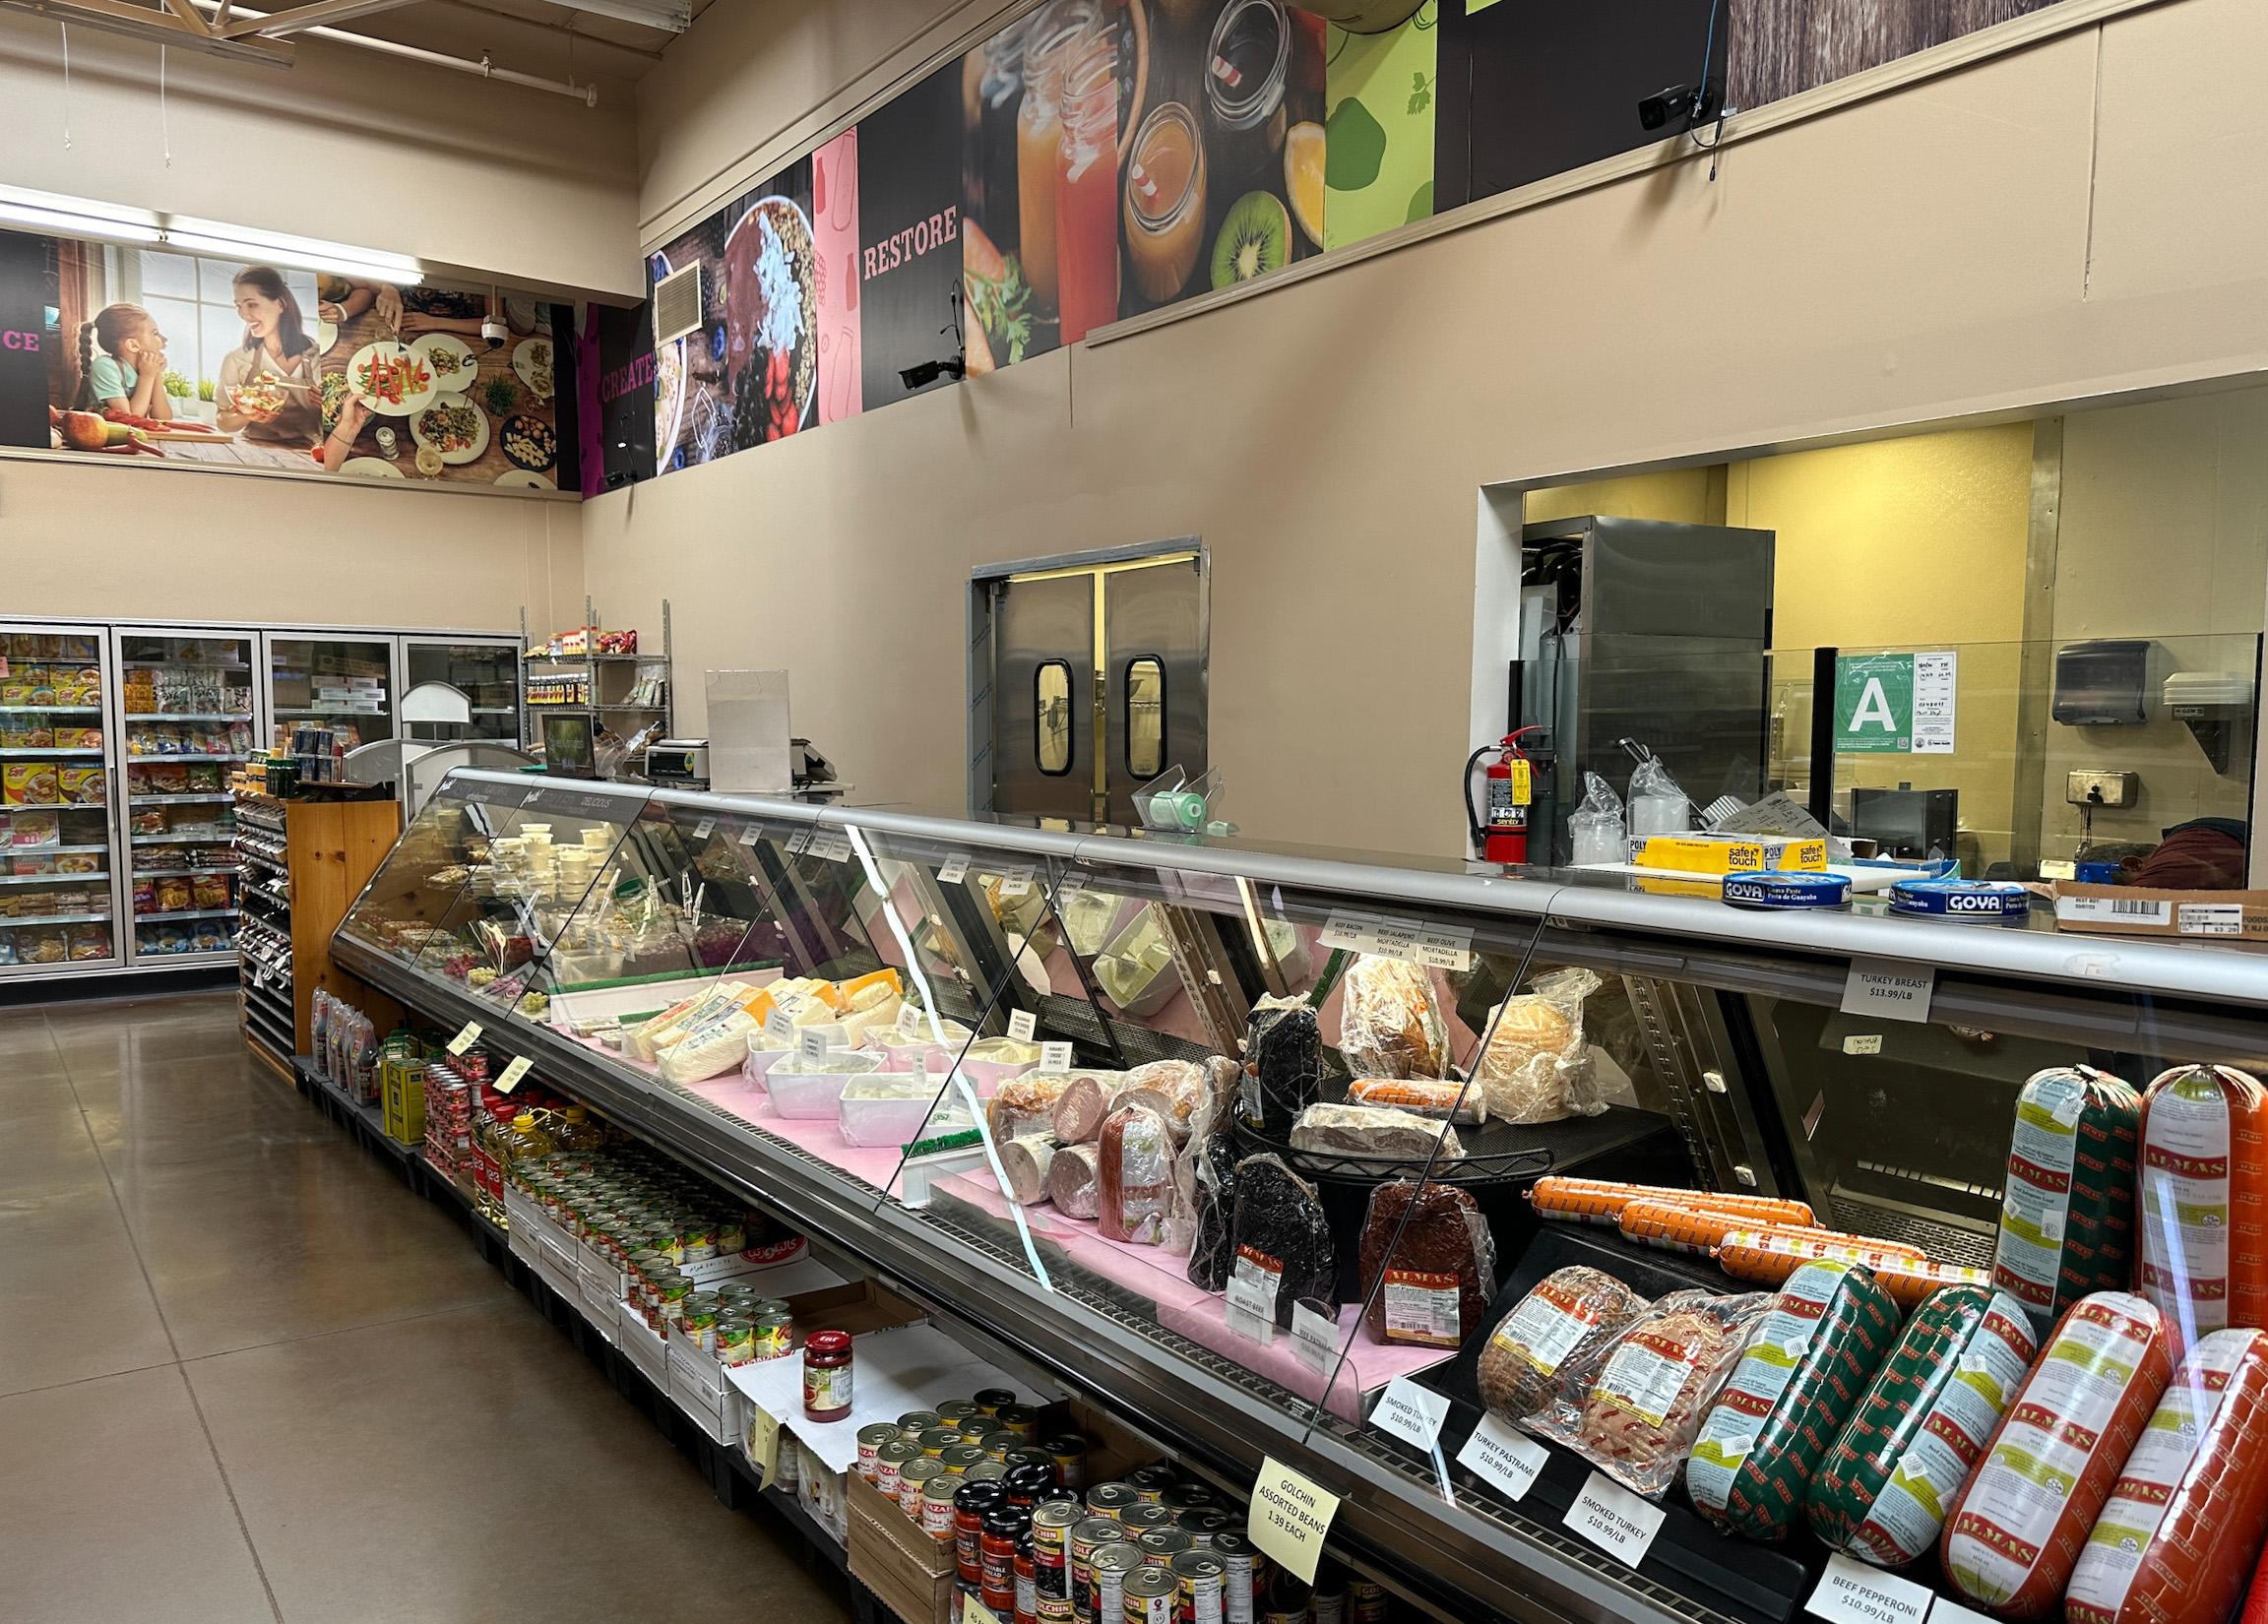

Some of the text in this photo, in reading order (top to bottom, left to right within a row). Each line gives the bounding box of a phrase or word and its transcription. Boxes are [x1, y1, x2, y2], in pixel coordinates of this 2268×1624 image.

[864, 205, 957, 281] RESTORE
[0, 330, 39, 351] CE
[602, 352, 654, 404] CREATE
[1849, 677, 1897, 731] A
[1630, 840, 1647, 850] POLY
[1729, 846, 1750, 857] safe
[1764, 846, 1782, 857] POLY
[1800, 845, 1816, 855] safe
[1729, 854, 1757, 866] touch
[1800, 853, 1822, 863] touch
[1726, 883, 1764, 900] GOYA
[1949, 896, 2001, 909] GOYA
[1346, 922, 1363, 931] BACON
[1376, 938, 1410, 949] MORTADELLA
[1421, 946, 1458, 957] MORTADELLA
[1441, 938, 1456, 947] OLIVE
[1860, 974, 1927, 989] TURKEY BREAST
[1869, 987, 1913, 1000] $13.99/LB
[2147, 1152, 2225, 1174] ALMAS
[2011, 1161, 2067, 1188] ALMAS
[1243, 1244, 1281, 1269] ALMAS
[1388, 1271, 1456, 1284] ALMAS
[1996, 1271, 2052, 1300] ALMAS
[1234, 1295, 1265, 1314] ROAST BEEF
[2077, 1307, 2149, 1340] ALMAS
[1985, 1318, 2034, 1363] ALMAS
[1385, 1396, 1417, 1416] SMOKED
[1390, 1411, 1422, 1433] $10.99/LB
[2016, 1407, 2093, 1447] ALMAS
[1475, 1431, 1535, 1477] TURKEY PASTRAMI
[1927, 1444, 1939, 1454] Beef
[1480, 1452, 1514, 1478] $10.99/LB
[1281, 1479, 1316, 1508] GOLCHIN
[1259, 1485, 1326, 1534] ASSORTED BEANS
[1582, 1496, 1647, 1539] SMOKED TURKEY
[1268, 1510, 1306, 1542] 1.39 EACH
[1588, 1515, 1626, 1544] $10.99/LB
[1958, 1518, 2034, 1562] ALMAS
[1832, 1575, 1918, 1617] BEEF PEPPERONI
[1841, 1594, 1895, 1624] $10.99/LB
